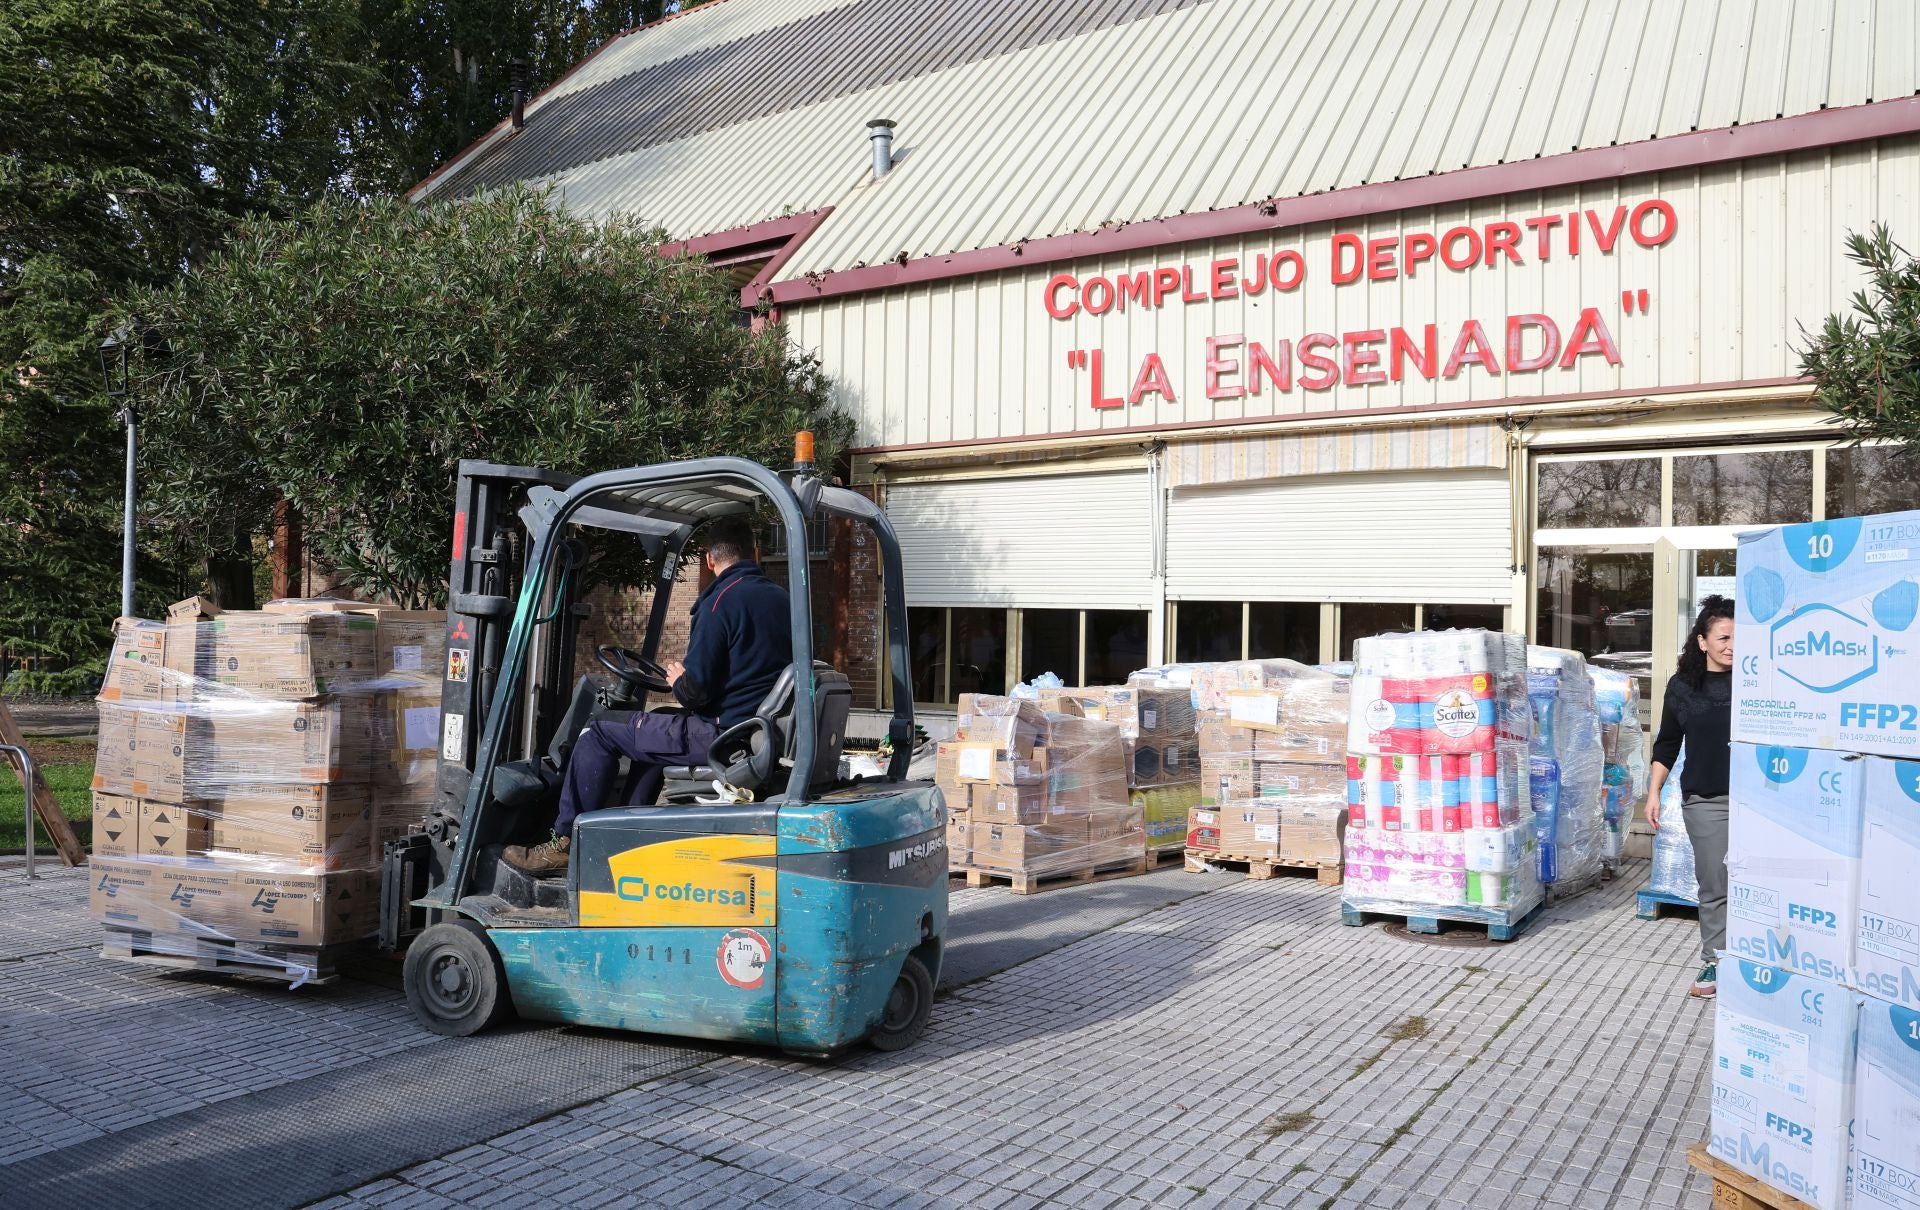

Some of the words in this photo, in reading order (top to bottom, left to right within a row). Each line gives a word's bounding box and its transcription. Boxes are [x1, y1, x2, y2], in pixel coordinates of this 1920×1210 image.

[1044, 249, 1305, 321] COMPLEJO
[1330, 199, 1676, 285] DEPORTIVO
[1871, 527, 1893, 540] 117
[1807, 534, 1833, 559] 10
[1743, 679, 1759, 688] 2841
[1740, 699, 1796, 710] MASCARILLA
[1437, 708, 1476, 722] Scottex
[1740, 709, 1791, 719] AUTOFILTRANTE
[1793, 711, 1813, 720] FFP2
[1816, 712, 1827, 720] NR
[1839, 702, 1918, 731] FFP2
[1772, 757, 1789, 775] 10
[1820, 796, 1841, 807] 2841
[655, 882, 746, 906] cofersa
[1733, 886, 1750, 900] 117
[1753, 890, 1774, 905] BOX
[1788, 903, 1836, 929] FFP2
[1862, 915, 1883, 931] 117
[1887, 922, 1912, 940] BOX
[1866, 931, 1873, 939] 10
[627, 943, 692, 965] 0111
[737, 941, 753, 952] 1m
[1867, 941, 1879, 951] 1170
[1753, 966, 1772, 985] 10
[1801, 1014, 1822, 1027] 2841
[1740, 1023, 1780, 1040] MASCARILLA
[1909, 1020, 1920, 1040] 1
[1747, 1048, 1770, 1064] FFP2
[1730, 1092, 1752, 1111] BOX
[1765, 1111, 1813, 1146] FFP2
[1861, 1158, 1884, 1177] 117
[1888, 1169, 1916, 1192] BOX
[1866, 1175, 1874, 1183] 10
[1866, 1184, 1878, 1195] 170
[1879, 1191, 1900, 1205] MASK
